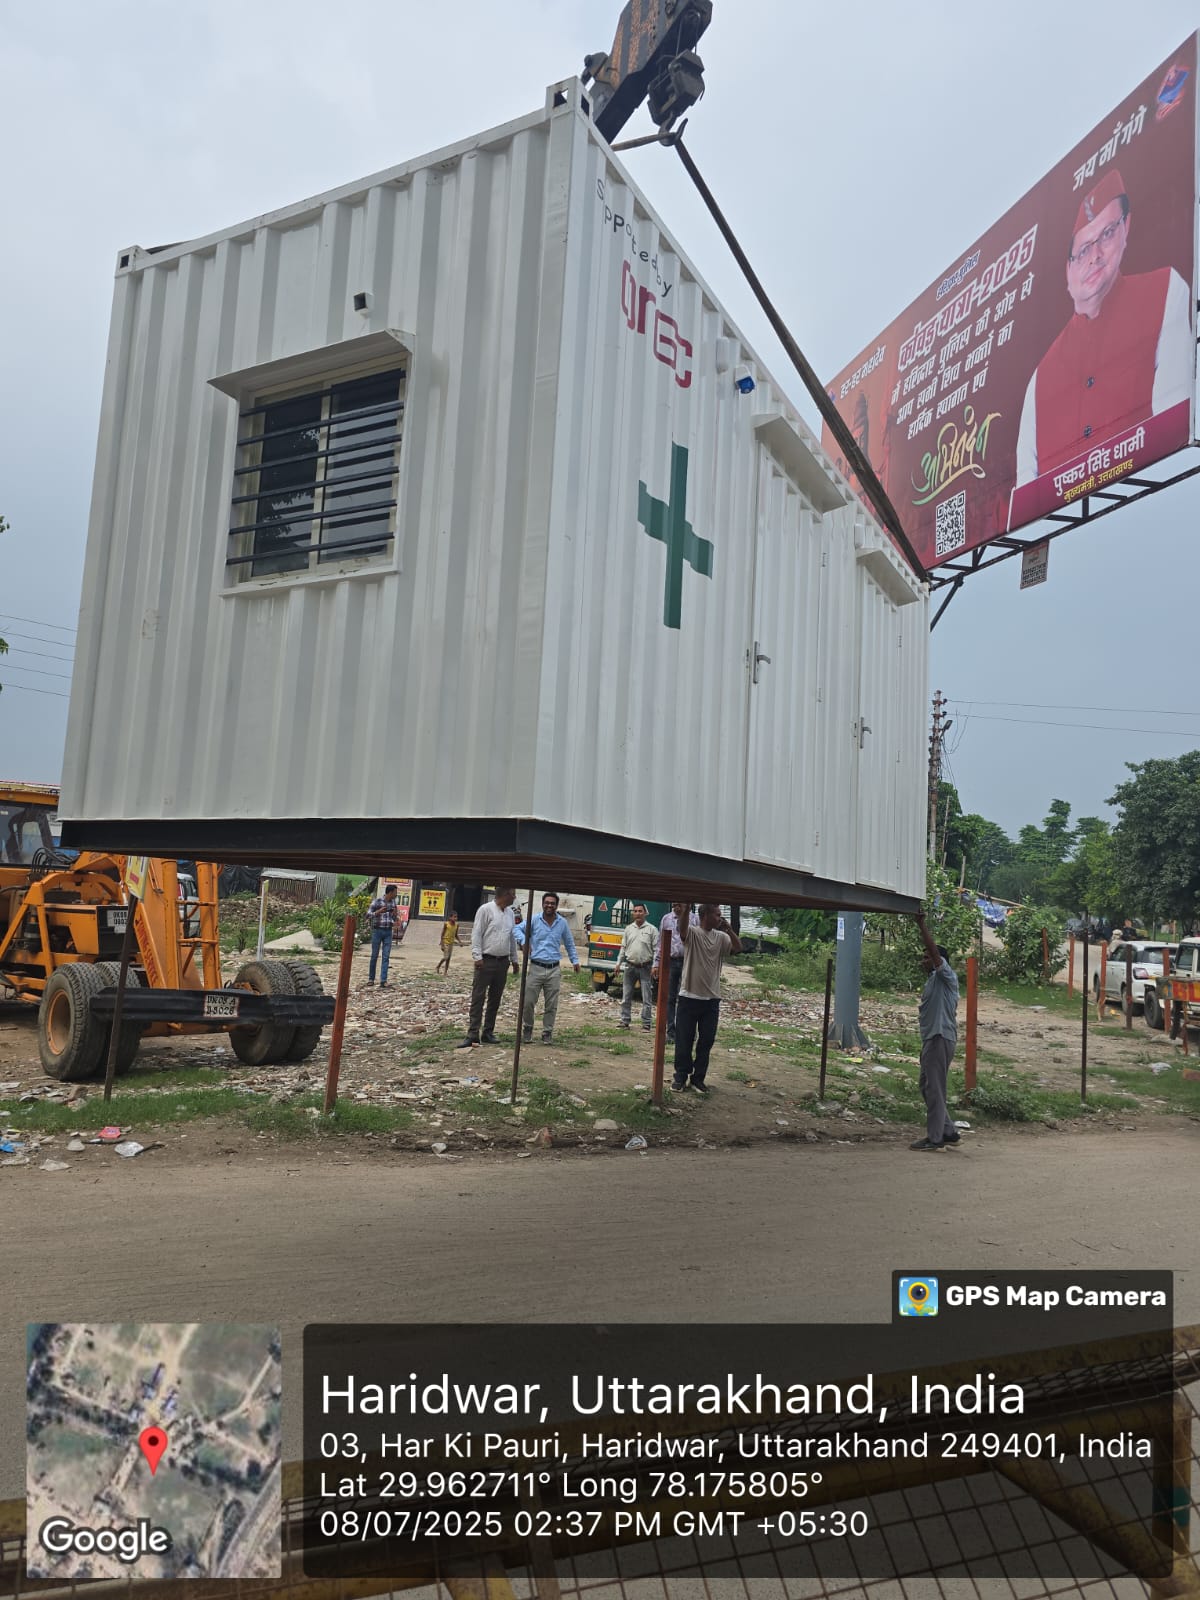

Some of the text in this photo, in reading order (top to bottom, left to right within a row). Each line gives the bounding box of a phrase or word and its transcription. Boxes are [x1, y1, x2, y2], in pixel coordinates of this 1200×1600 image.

[1073, 152, 1099, 191] जय
[1121, 104, 1147, 144] गंगे
[891, 380, 901, 405] में
[938, 324, 972, 374] पुलिस
[975, 307, 990, 336] की
[994, 289, 1017, 322] ओर
[1020, 272, 1034, 301] से
[896, 398, 914, 424] आप
[917, 376, 938, 409] सभी
[941, 361, 962, 391] शिव
[997, 320, 1014, 346] का
[908, 361, 989, 440] हार्दिक स्वागत एवं
[1053, 426, 1145, 497] पुष्कर सिंह धामी
